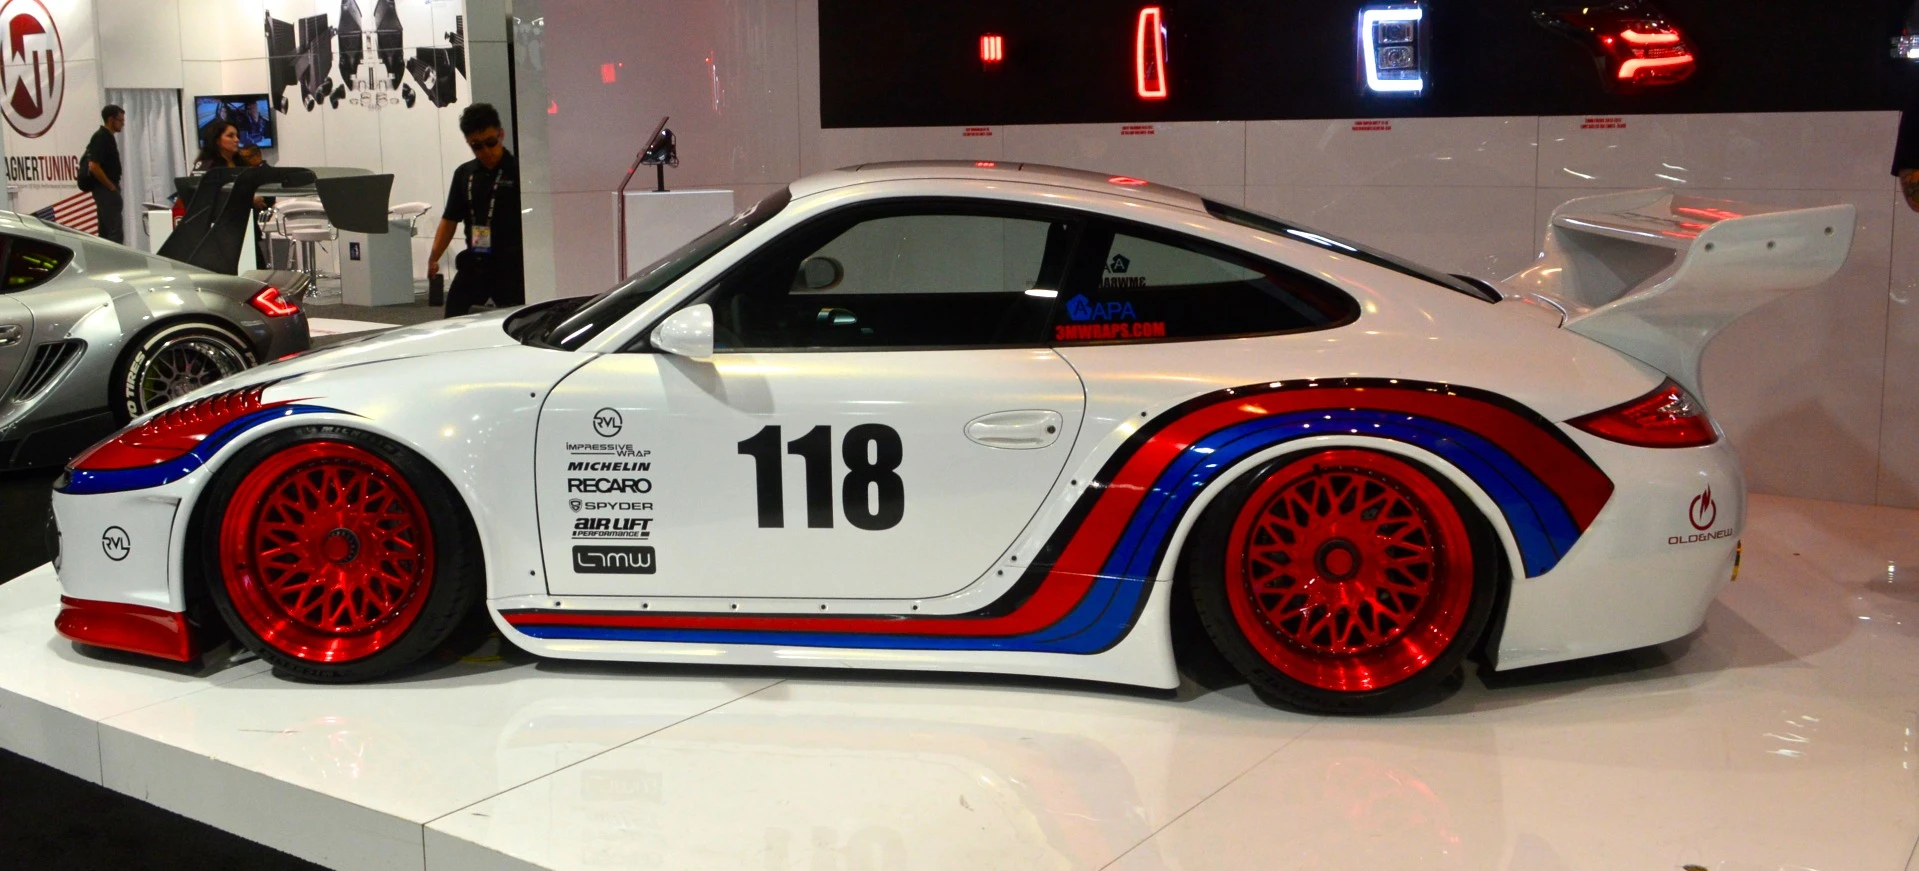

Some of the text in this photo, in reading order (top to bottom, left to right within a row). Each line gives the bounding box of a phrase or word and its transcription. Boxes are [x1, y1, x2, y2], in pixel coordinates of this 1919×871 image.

[1093, 302, 1136, 320] APA
[1056, 322, 1165, 340] 3MWRAPS.COM
[126, 350, 146, 398] TIRES
[567, 461, 651, 471] MICHELIN
[567, 477, 652, 494] RECARO
[737, 423, 905, 531] 118
[584, 502, 653, 511] SPYDER
[612, 518, 654, 531] LIFT
[1668, 528, 1733, 545] OLD&NEW
